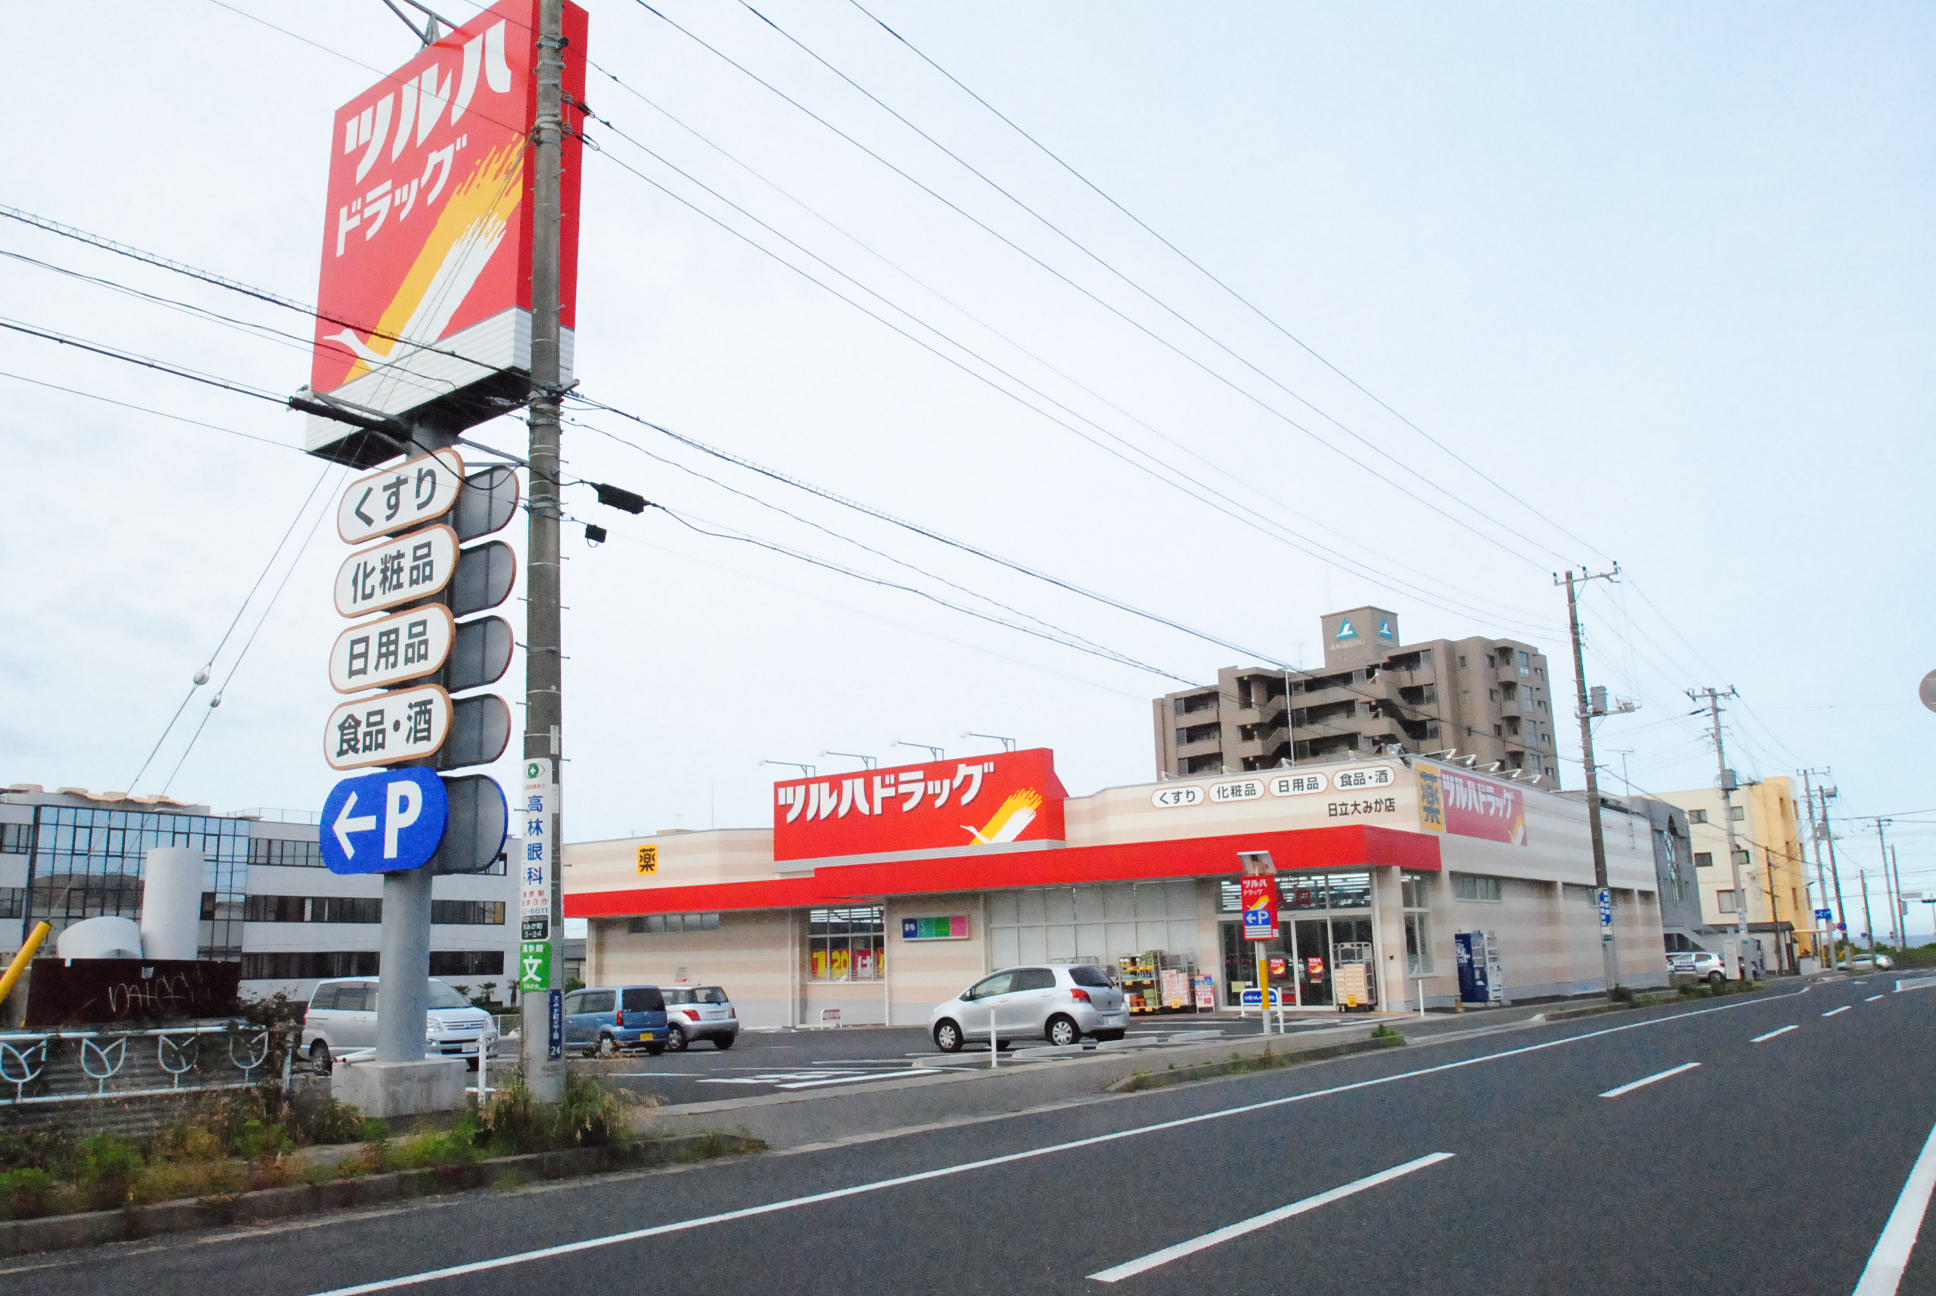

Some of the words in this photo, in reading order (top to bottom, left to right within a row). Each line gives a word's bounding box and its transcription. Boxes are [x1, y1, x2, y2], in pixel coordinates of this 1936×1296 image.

[344, 19, 512, 185] ツルハ
[336, 134, 468, 257] ドラッグ
[355, 466, 437, 528] くすり
[351, 540, 434, 605] 化粧品
[348, 618, 429, 679] 日用品
[336, 698, 434, 758] 食品・酒
[778, 761, 995, 824] ツルハドラッグ
[1158, 790, 1196, 805] くすり
[1216, 783, 1257, 799] 化粧品
[1278, 777, 1319, 792] 日用品
[1328, 798, 1396, 817] 日立大みか店
[1340, 769, 1388, 788] 食品・酒
[1420, 772, 1441, 824] 薬
[383, 780, 423, 859] P
[526, 795, 544, 886] 高林眼科
[639, 847, 656, 872] 薬
